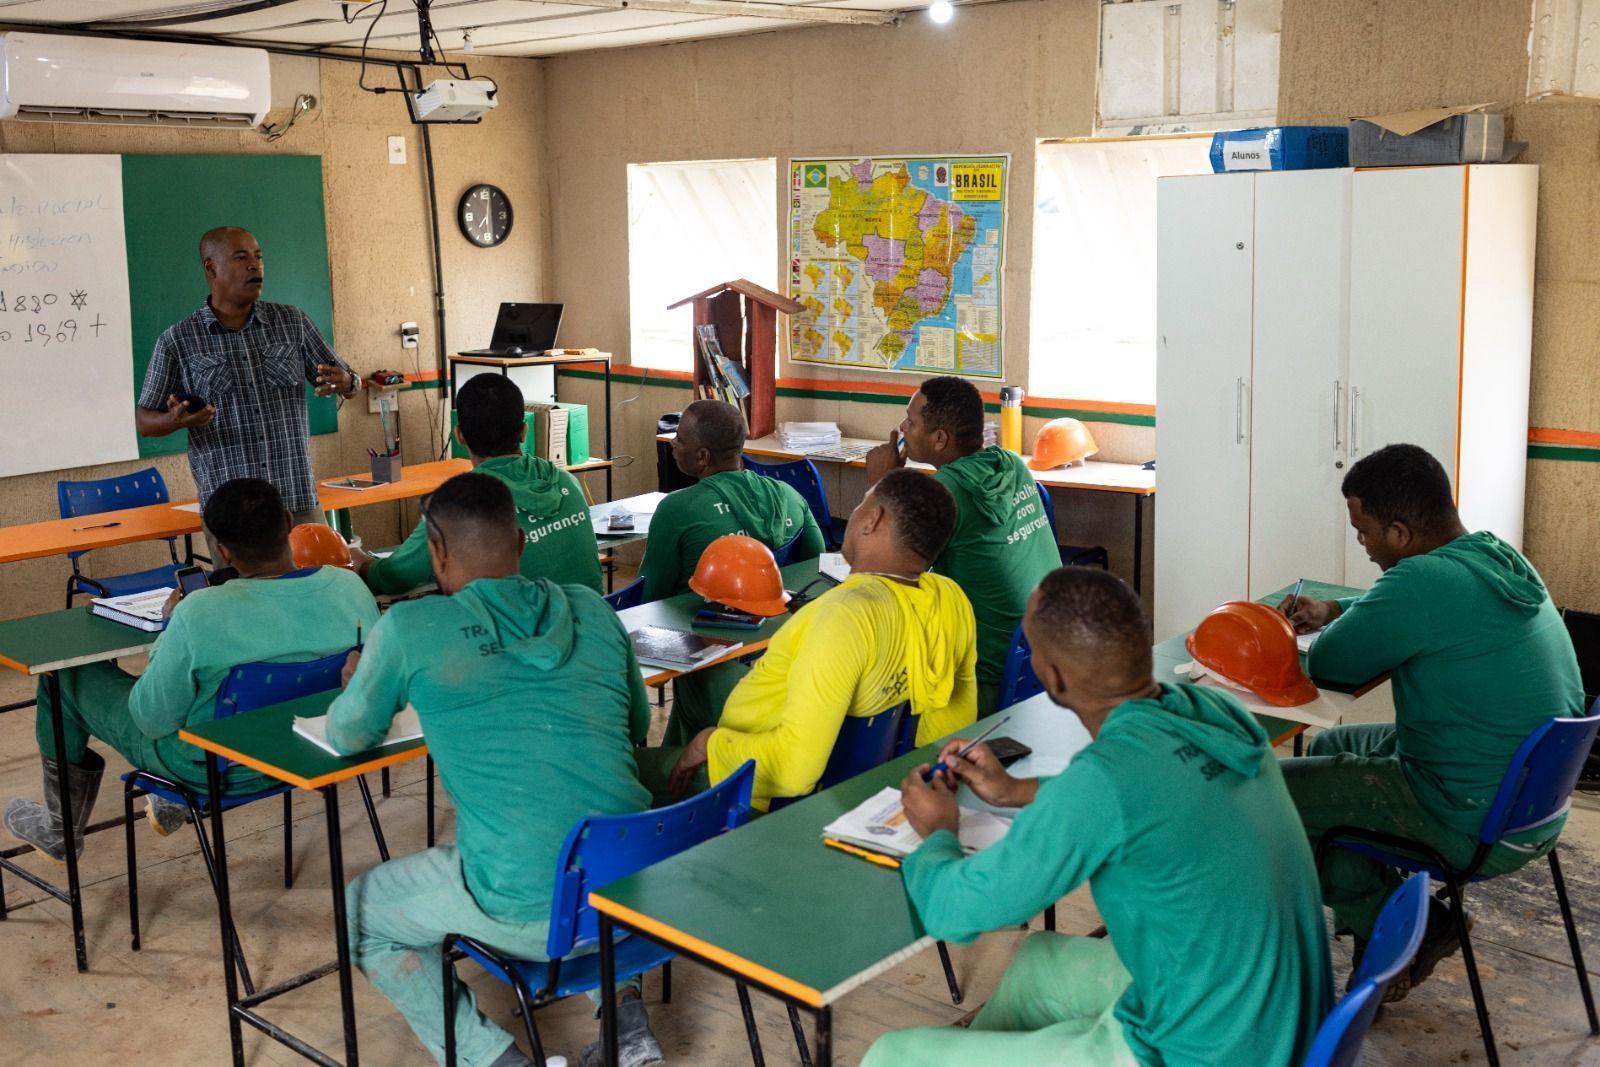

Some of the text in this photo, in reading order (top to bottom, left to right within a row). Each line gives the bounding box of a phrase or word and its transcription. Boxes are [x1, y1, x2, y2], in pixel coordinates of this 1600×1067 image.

[1231, 151, 1260, 160] Alunos
[955, 173, 998, 188] BRASIL
[1016, 503, 1035, 520] com
[525, 511, 587, 543] gurança
